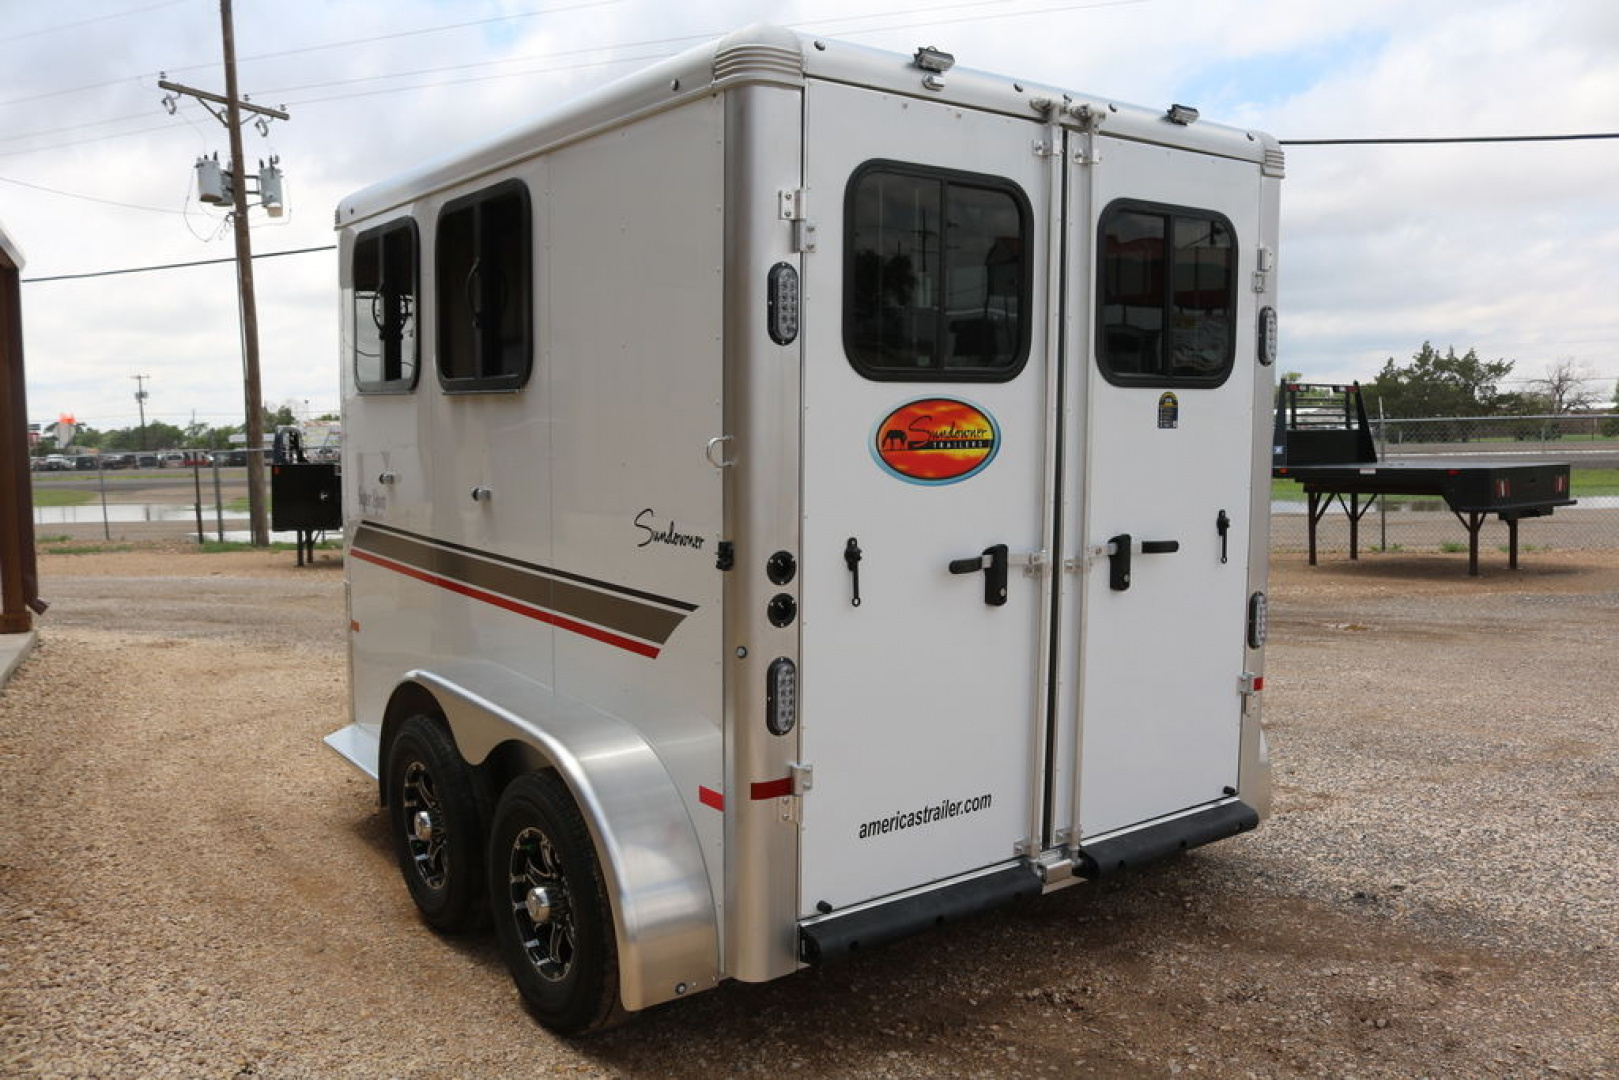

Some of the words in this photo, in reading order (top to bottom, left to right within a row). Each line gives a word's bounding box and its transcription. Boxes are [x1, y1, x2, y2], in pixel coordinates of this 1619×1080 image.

[908, 415, 988, 448] Sundowner
[634, 508, 705, 550] Sundowner
[858, 793, 992, 839] americastrailer.com
